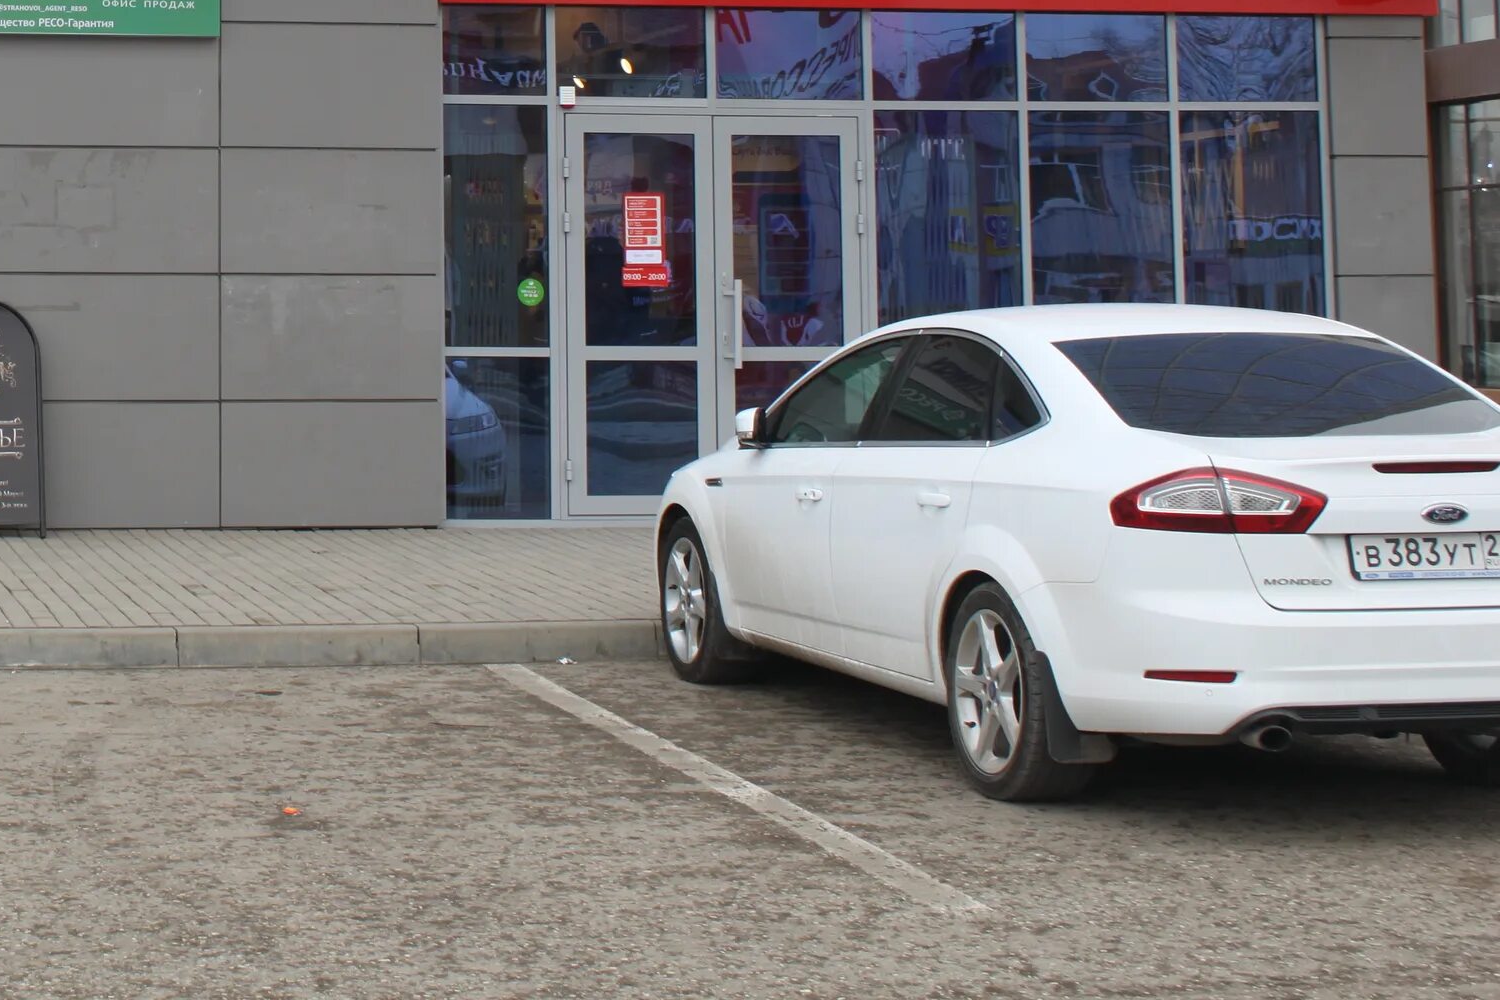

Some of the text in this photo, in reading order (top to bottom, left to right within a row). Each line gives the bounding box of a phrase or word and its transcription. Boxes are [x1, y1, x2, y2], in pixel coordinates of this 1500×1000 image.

[102, 0, 195, 10] ОФИС ПРОДАЖ
[38, 18, 114, 30] РЕСО-Гарантия
[1263, 578, 1333, 586] MONDEO
